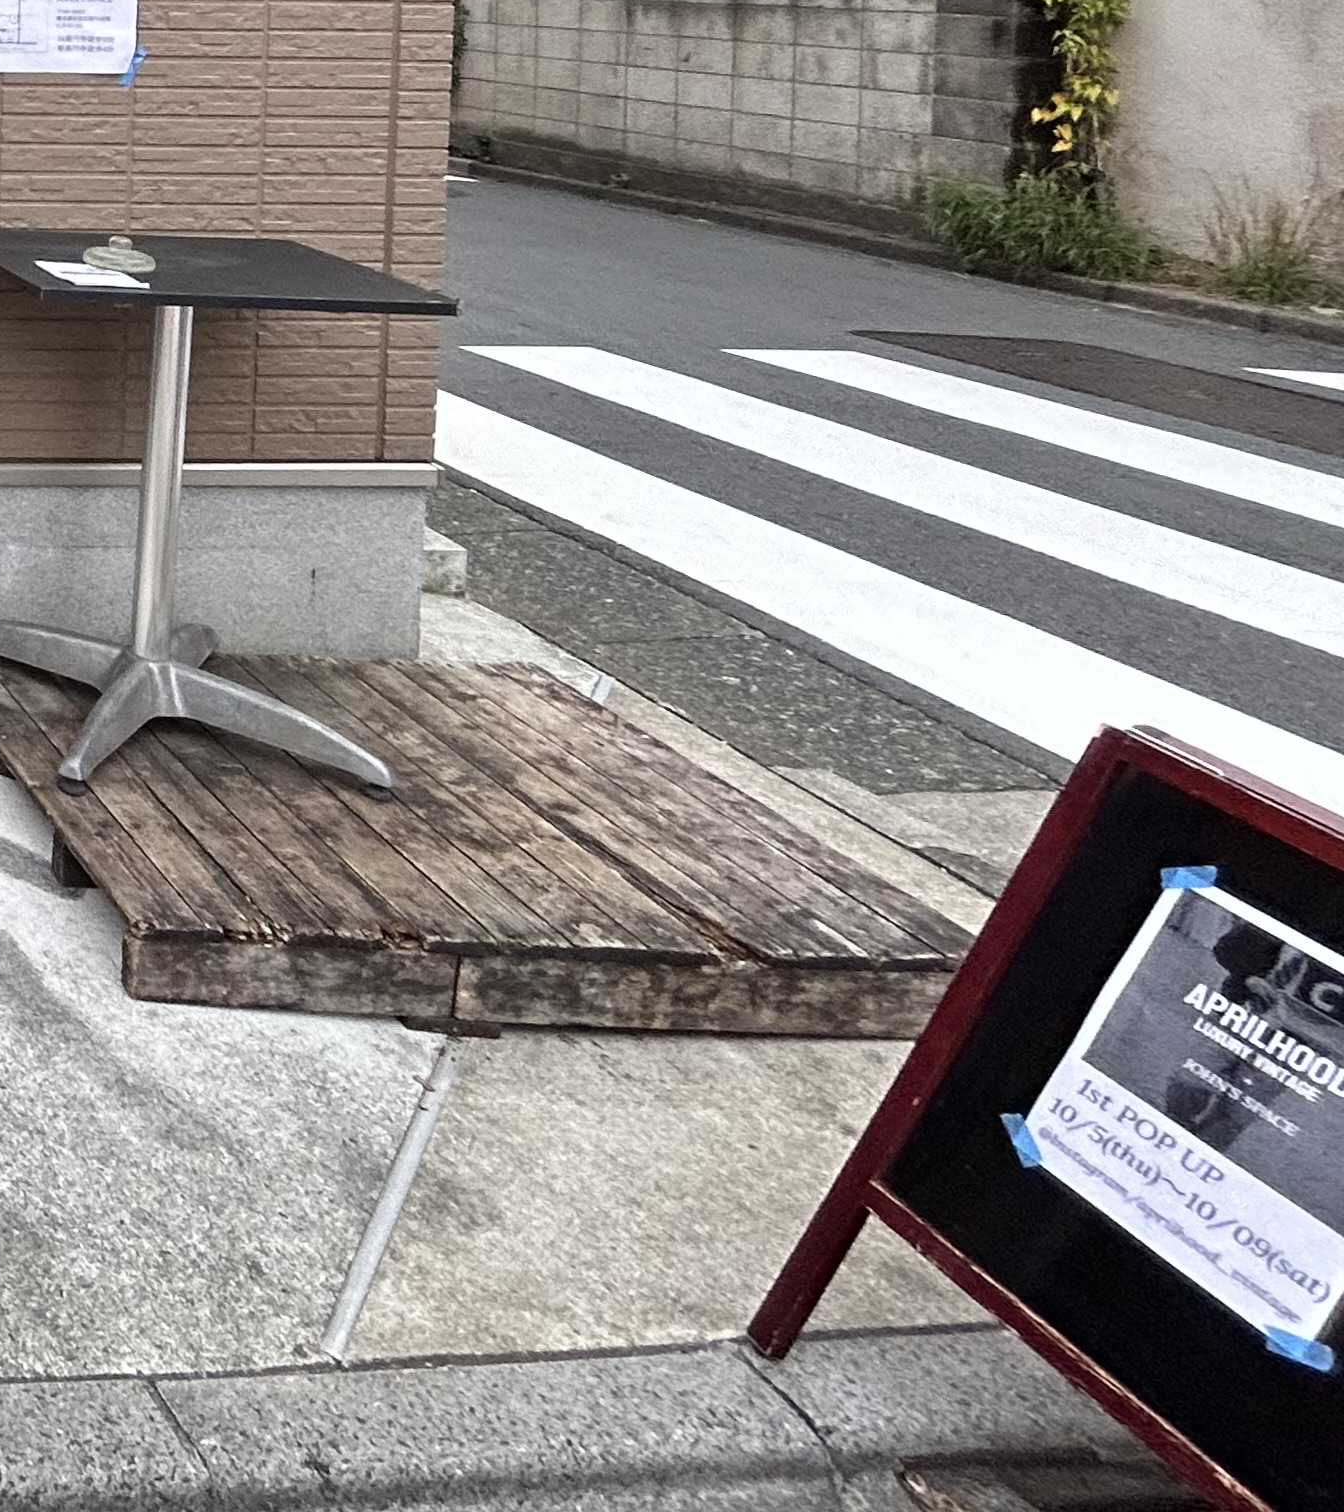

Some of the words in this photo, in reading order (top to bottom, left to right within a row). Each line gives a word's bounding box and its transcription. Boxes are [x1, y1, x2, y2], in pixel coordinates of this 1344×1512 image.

[1253, 1053, 1324, 1104] VINTAGE
[1077, 1079, 1113, 1112] 1st
[1116, 1104, 1178, 1150] POP
[1180, 1148, 1226, 1184] UP
[1241, 1095, 1300, 1137] SPACE
